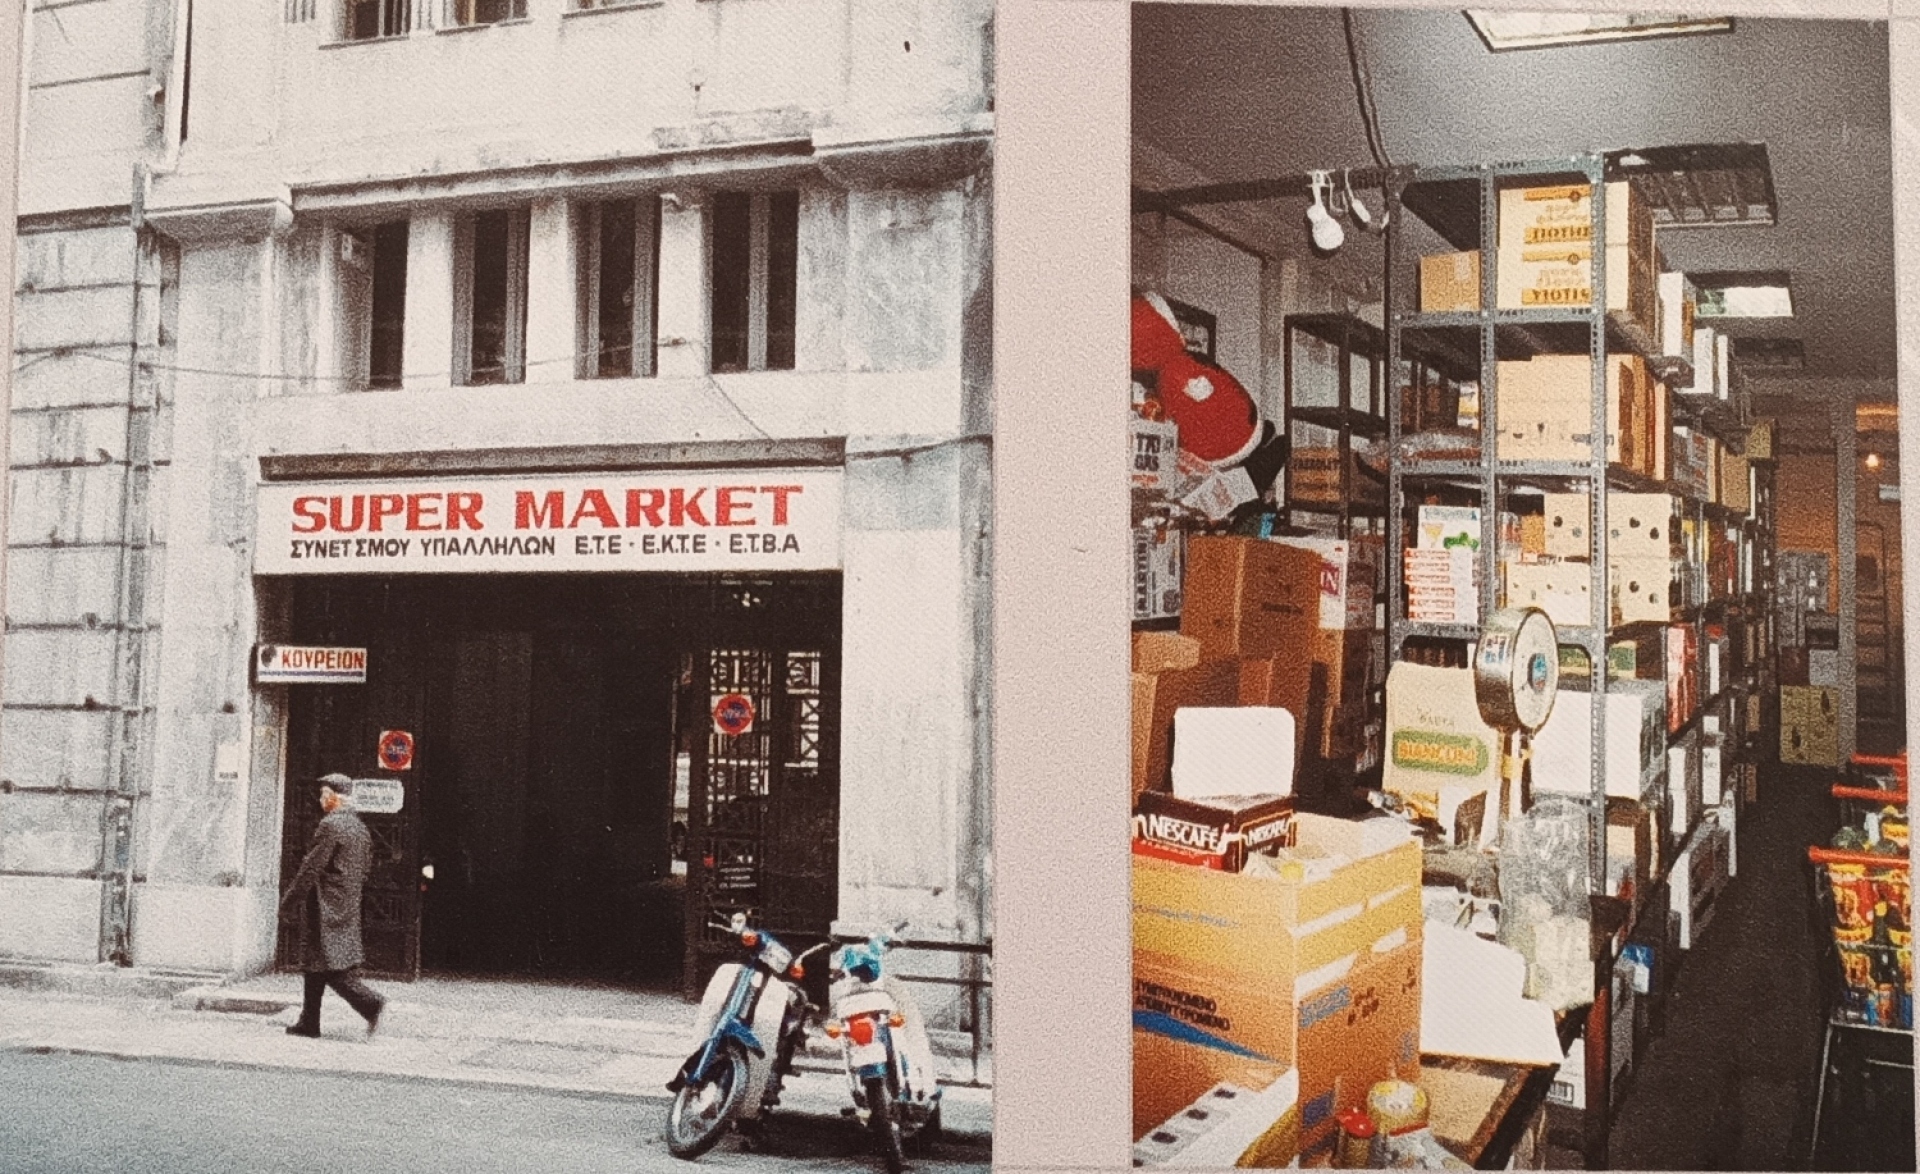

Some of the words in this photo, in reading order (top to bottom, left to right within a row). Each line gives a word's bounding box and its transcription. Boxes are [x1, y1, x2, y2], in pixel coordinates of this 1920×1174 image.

[291, 492, 484, 533] SUPER
[515, 485, 803, 530] MARKET
[420, 536, 555, 557] ΥΠΑΛΛΗΛΩΝ
[282, 649, 365, 670] ΚΟΥΡΕΙΟΝ
